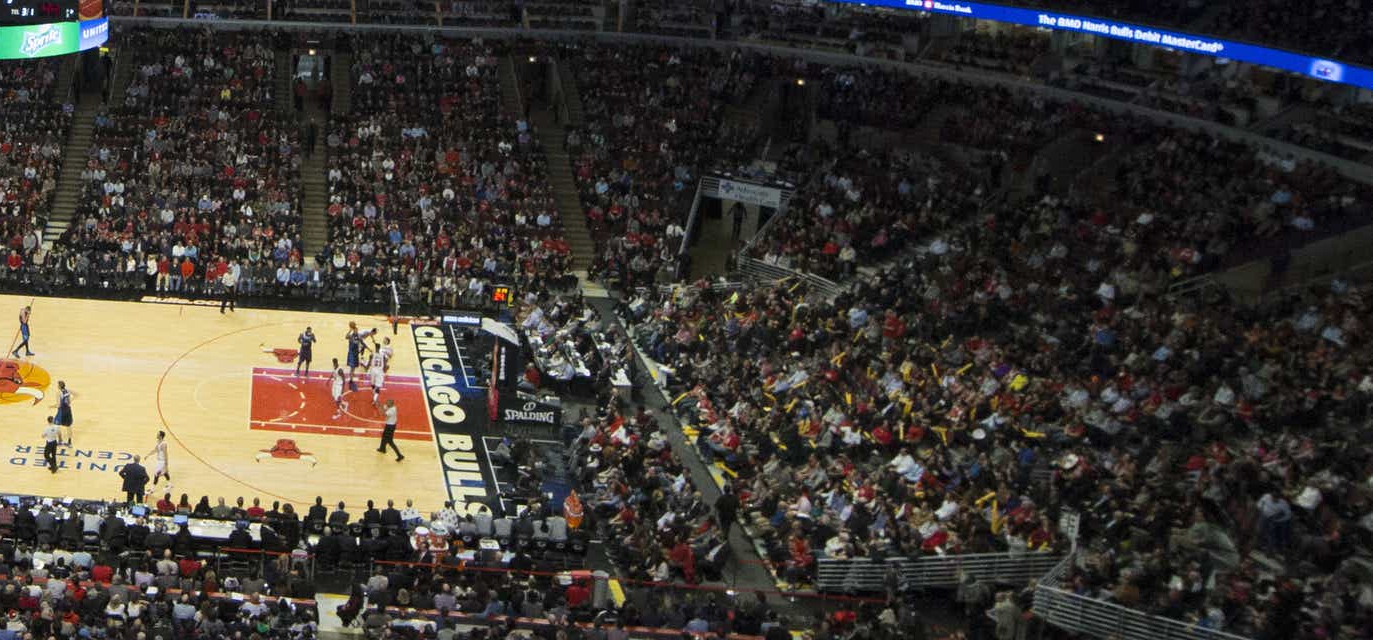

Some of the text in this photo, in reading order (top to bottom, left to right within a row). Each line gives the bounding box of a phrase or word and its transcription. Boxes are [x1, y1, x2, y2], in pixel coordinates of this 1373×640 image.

[25, 28, 59, 52] Sprite
[1038, 14, 1057, 26] The
[1082, 20, 1110, 35] Harris
[1110, 24, 1134, 39] Bulls
[1134, 29, 1161, 43] Debit
[414, 326, 466, 424] CHICAGO
[504, 409, 555, 423] SPALDING
[15, 444, 133, 460] CENTER
[10, 457, 127, 473] UNITED
[438, 433, 493, 519] BULLS
